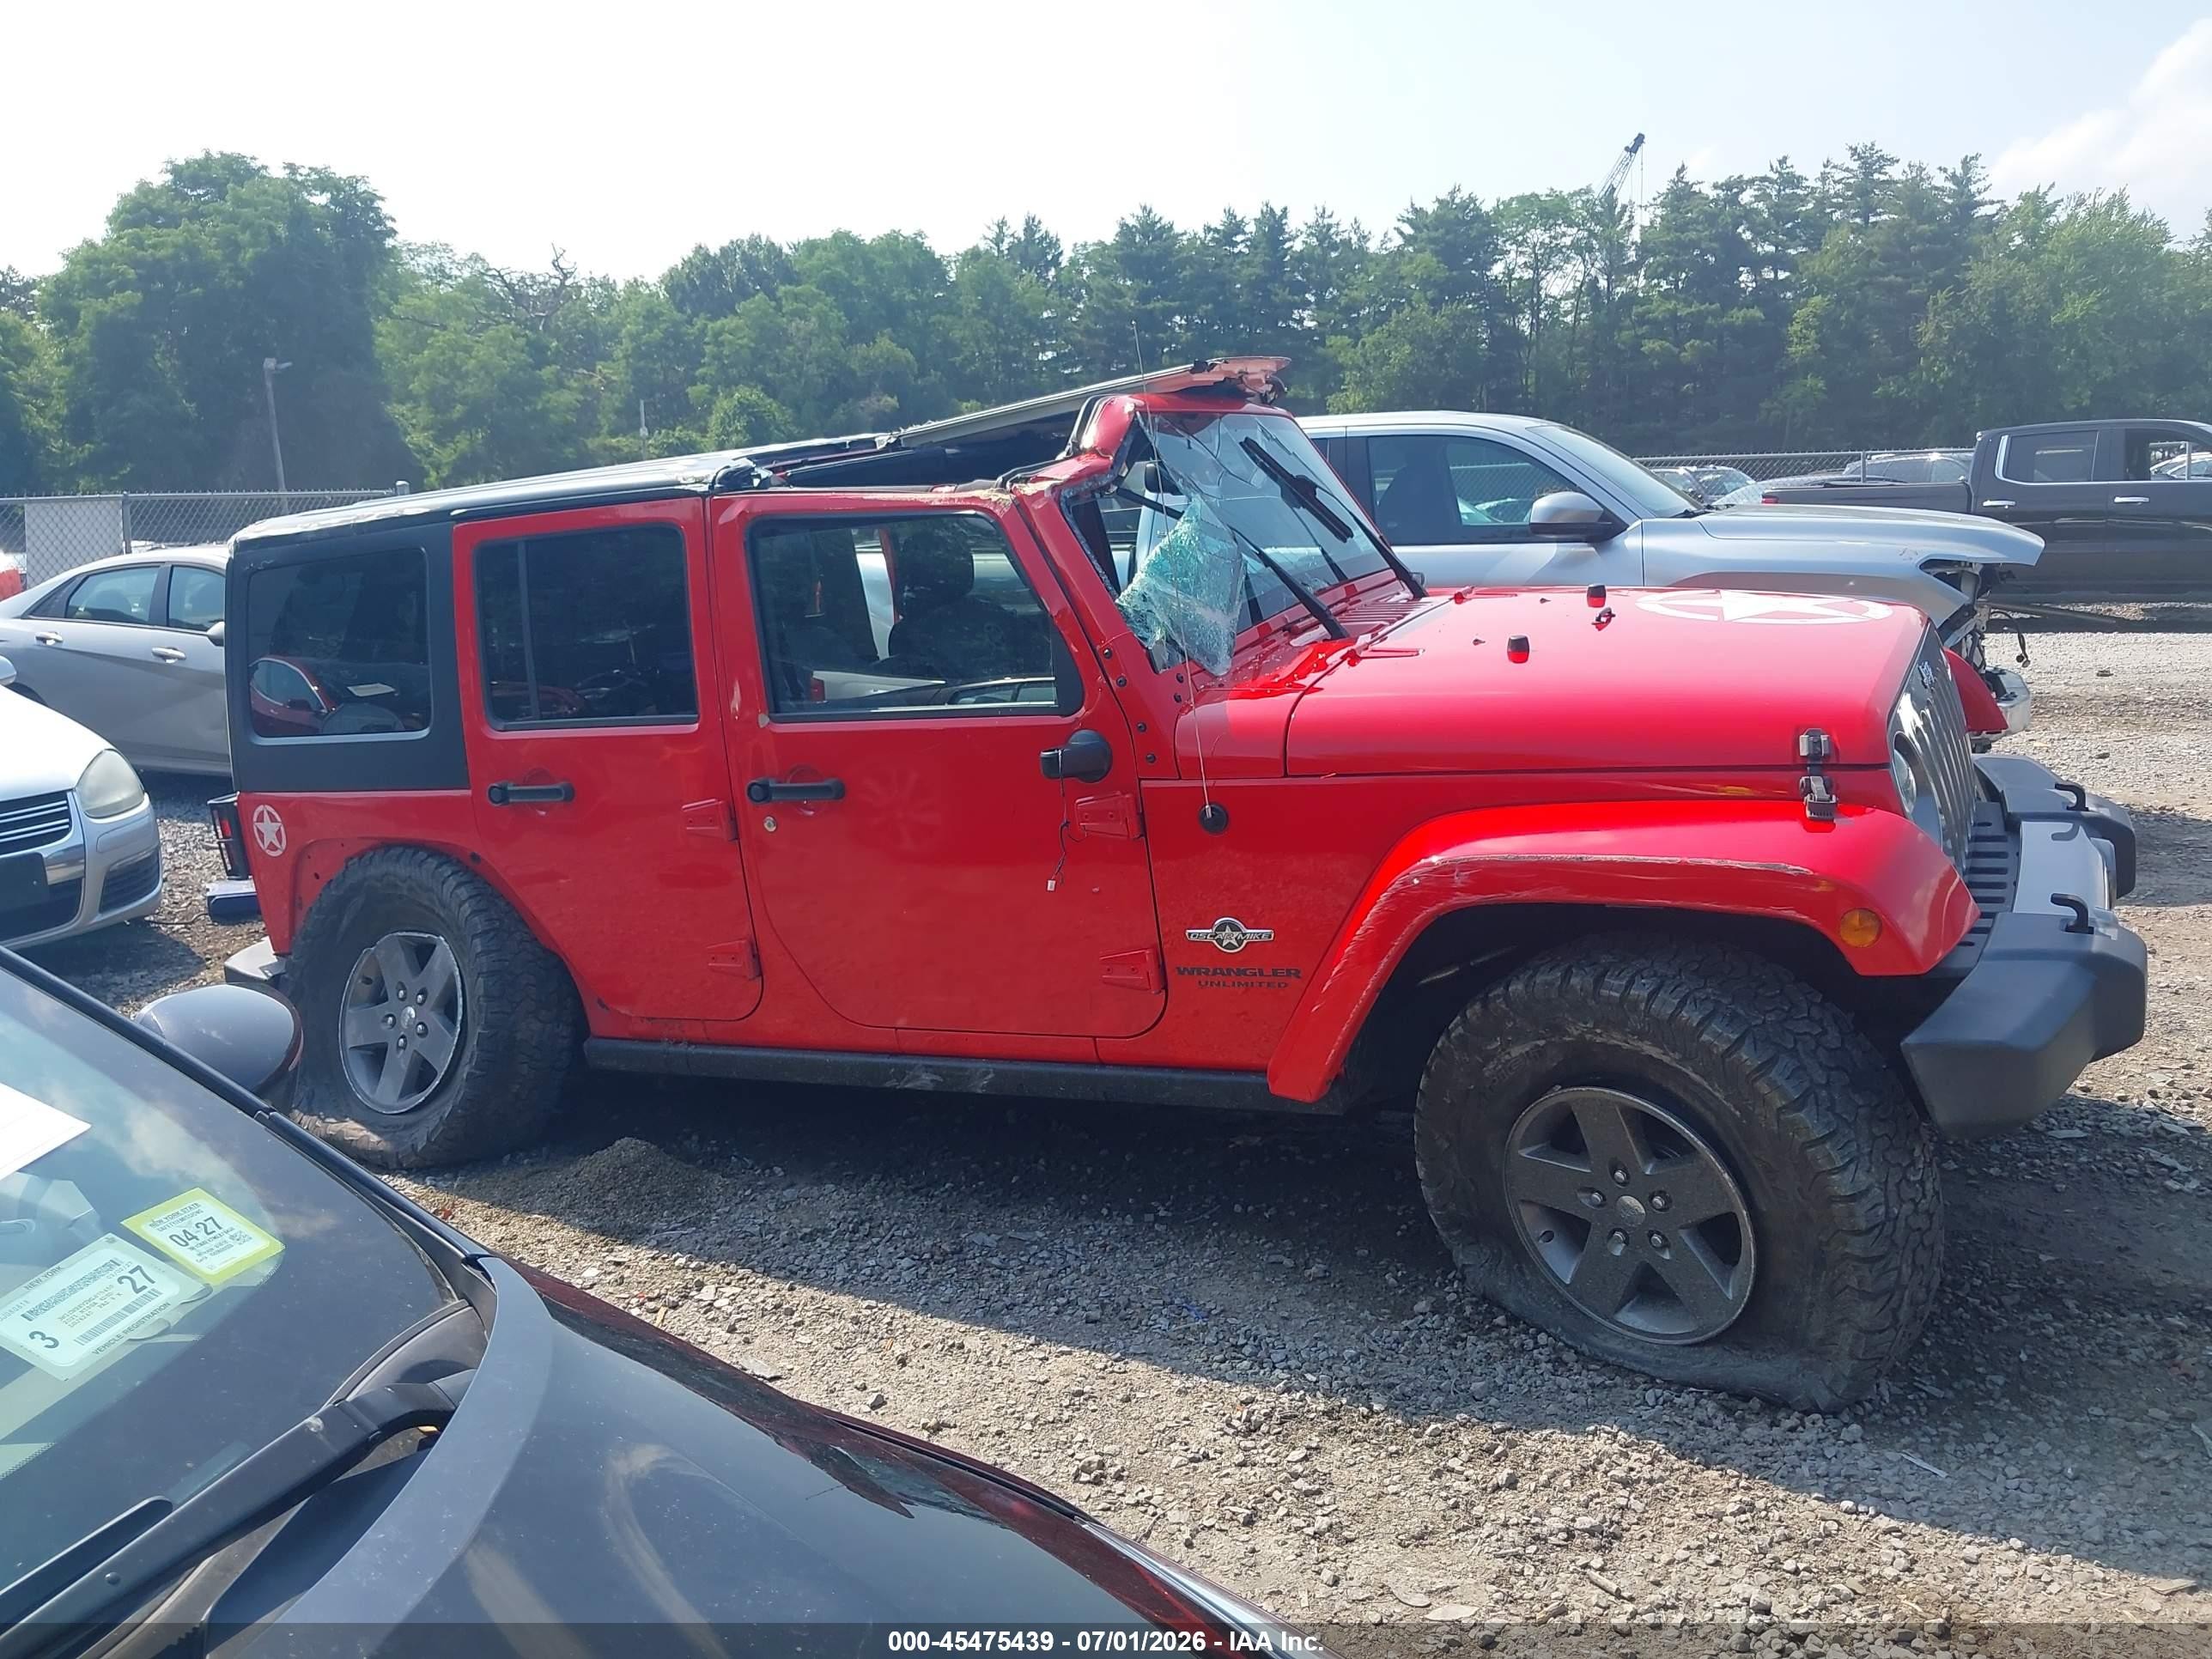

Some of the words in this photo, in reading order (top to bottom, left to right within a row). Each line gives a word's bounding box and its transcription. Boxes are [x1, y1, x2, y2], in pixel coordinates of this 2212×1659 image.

[1190, 932, 1235, 940] OSCAR
[1237, 932, 1271, 940] MIKE
[1176, 966, 1302, 979] WRANGLER
[1198, 980, 1289, 988] UNLIMITED
[163, 1209, 181, 1223] YORK
[179, 1202, 202, 1216] STATE
[24, 1277, 42, 1291] NEW
[41, 1265, 64, 1279] YORK
[117, 1264, 156, 1295] 27
[92, 1333, 125, 1356] VEHICLE
[123, 1302, 172, 1337] REGISTRATION
[28, 1330, 59, 1350] 3
